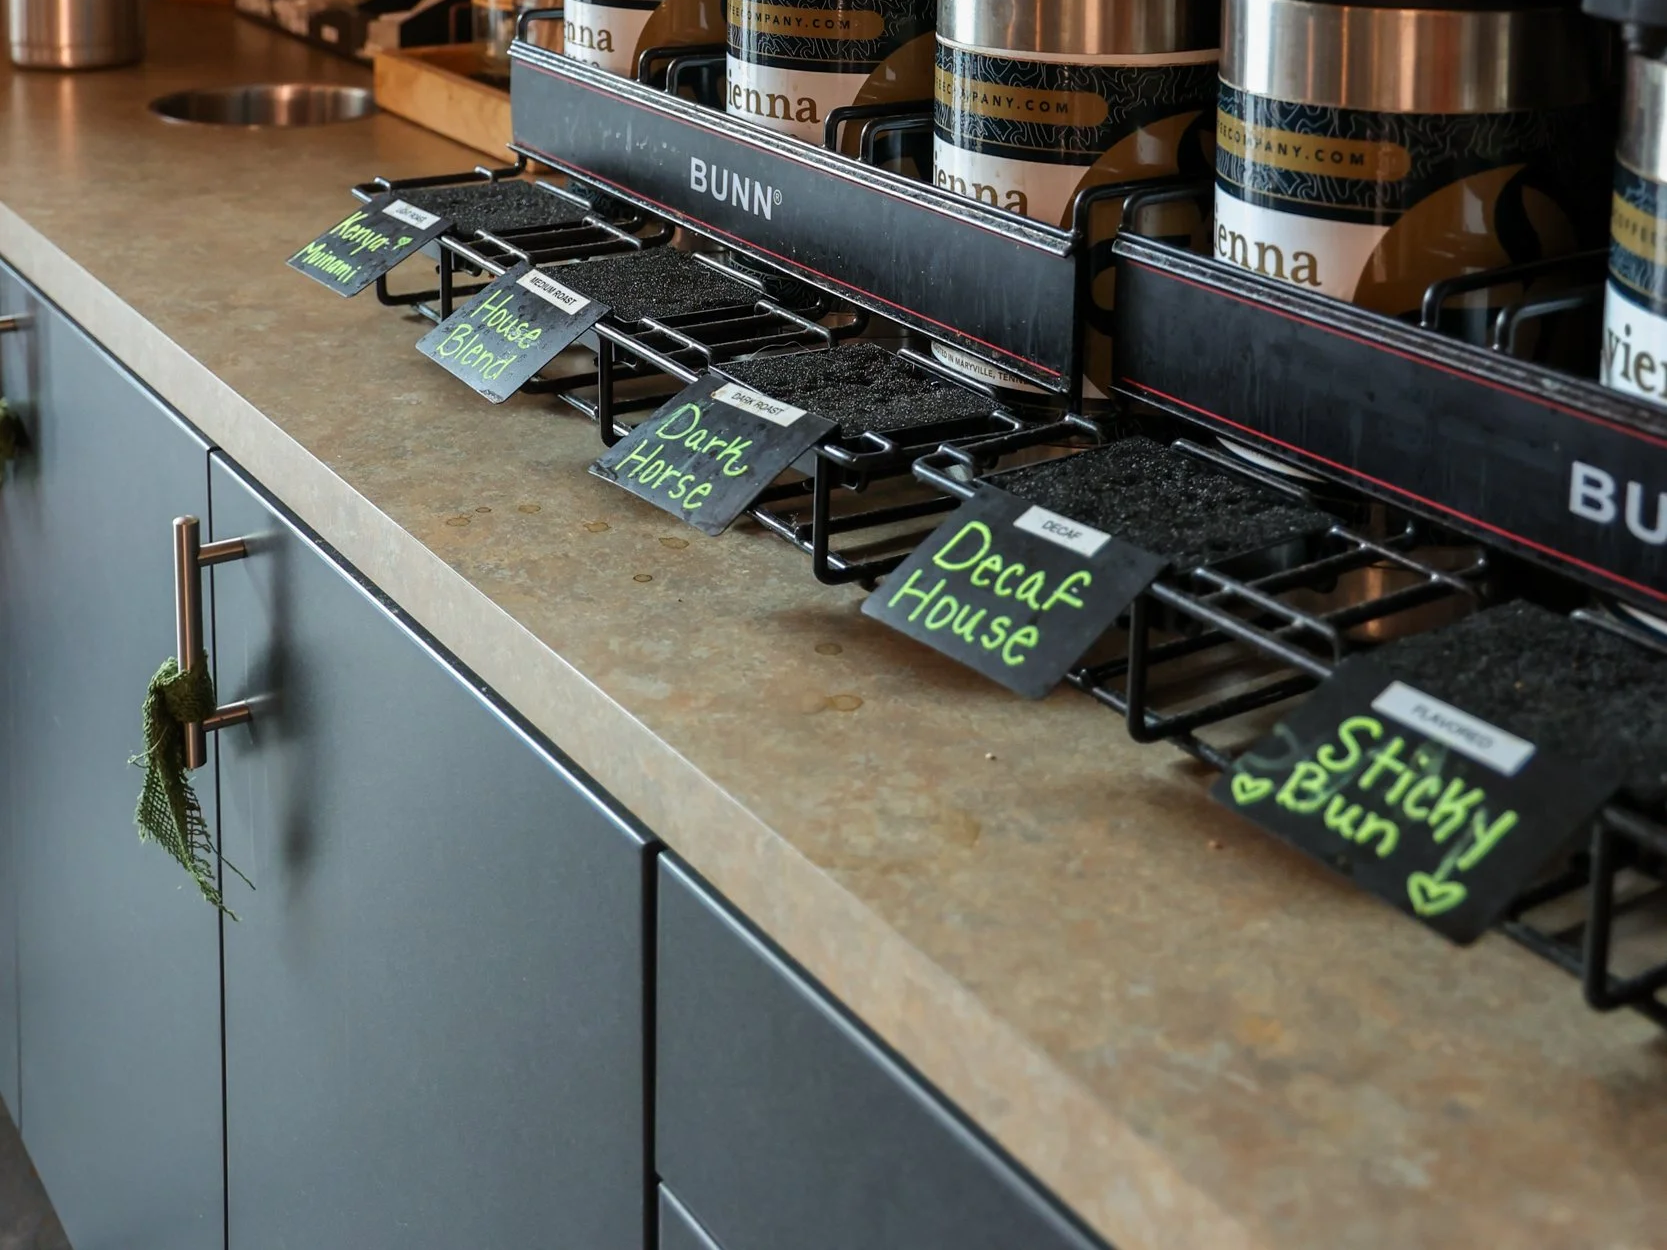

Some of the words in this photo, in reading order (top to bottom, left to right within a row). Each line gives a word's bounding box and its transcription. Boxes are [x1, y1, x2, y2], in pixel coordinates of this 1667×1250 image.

[564, 19, 615, 53] nna
[469, 289, 543, 350] House
[529, 276, 557, 295] MEDIUM
[552, 289, 578, 306] ROAST
[436, 323, 517, 382] Blend
[955, 356, 996, 380] MARYVILLE,
[731, 392, 756, 406] DARK
[753, 400, 785, 416] ROAST
[655, 402, 752, 477] Dark
[614, 438, 713, 510] Horse
[1041, 519, 1083, 541] DECAF
[932, 520, 1092, 611] Decaf
[887, 569, 1040, 667] House
[1410, 702, 1496, 749] FLAVORED
[1276, 760, 1400, 858] Bun
